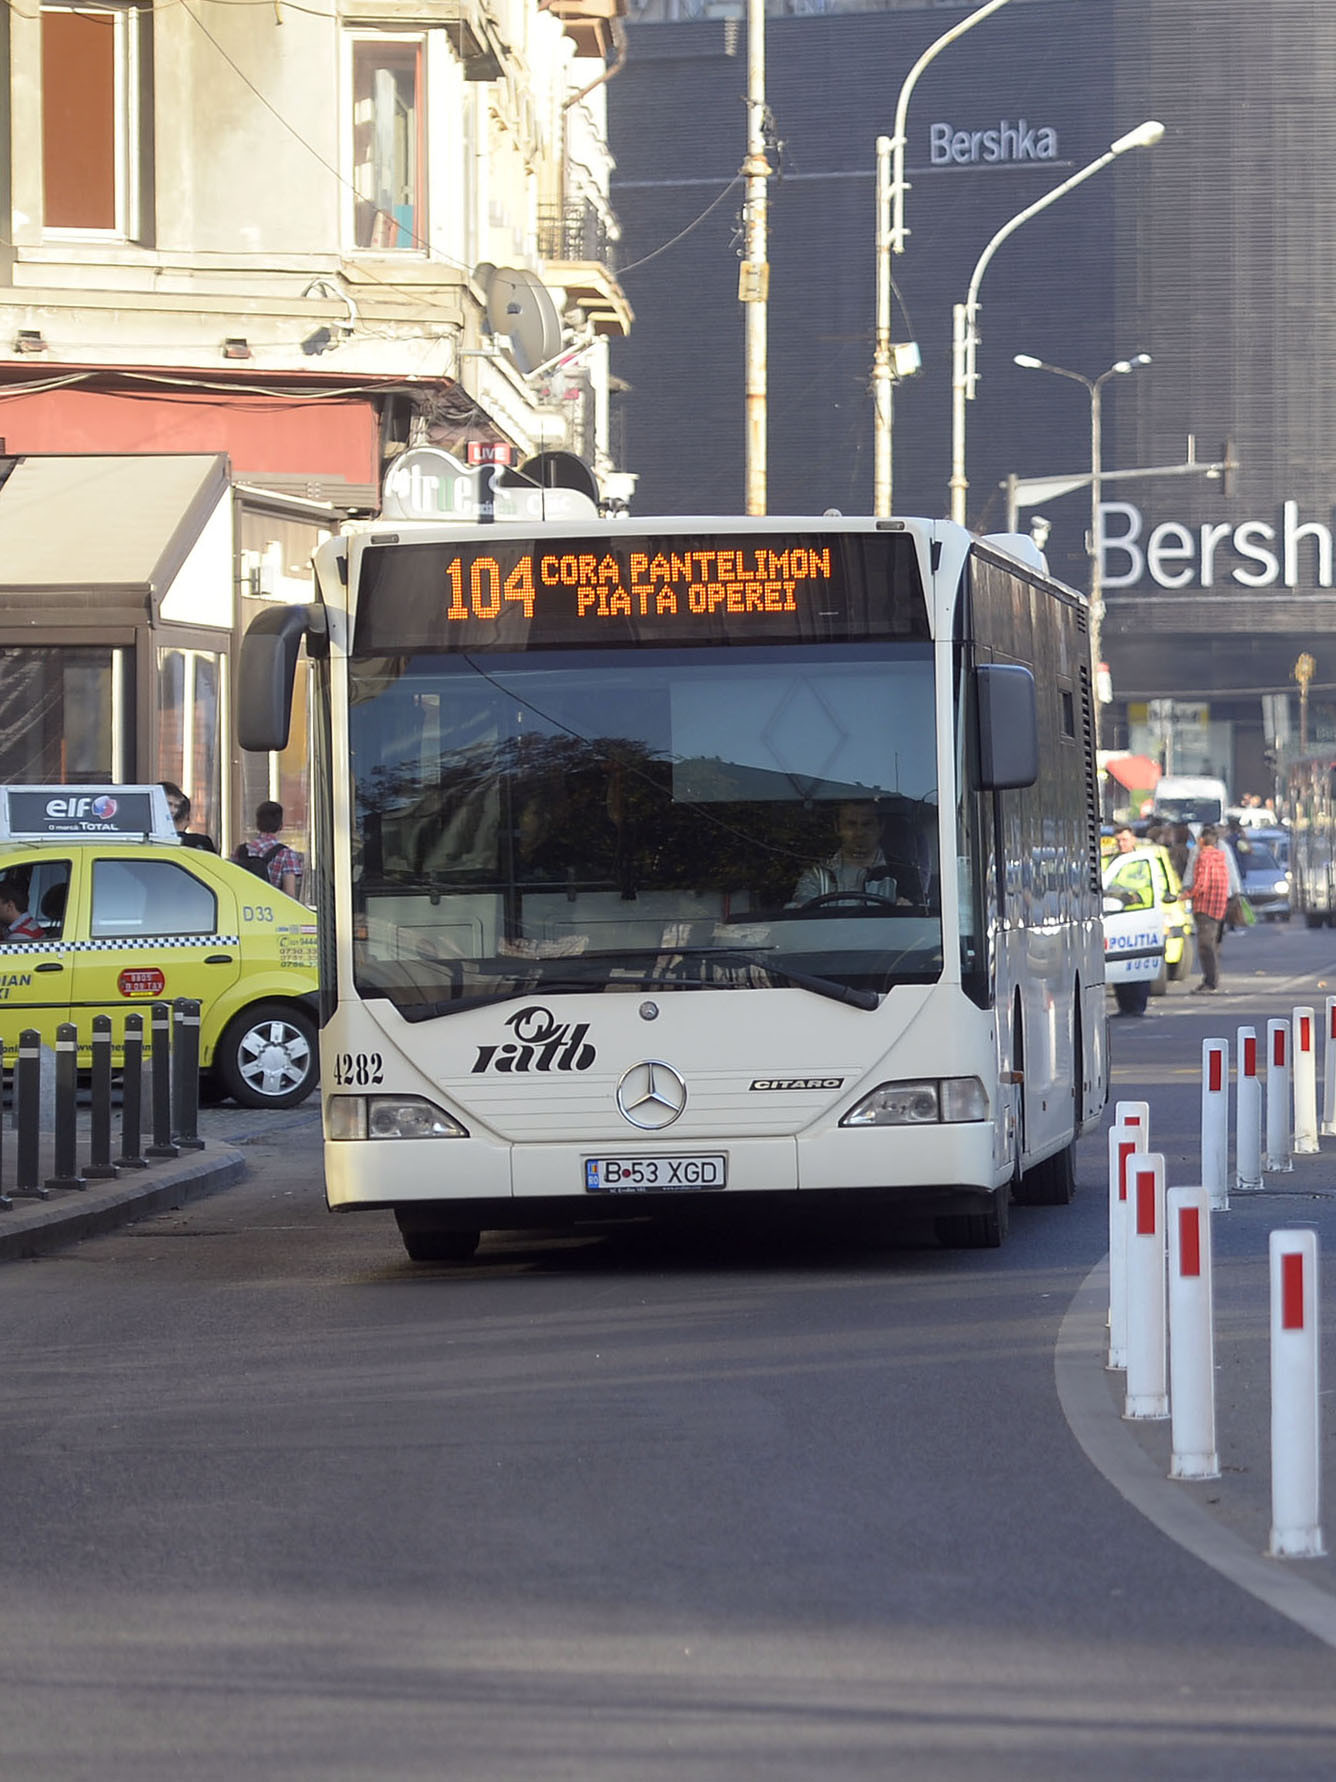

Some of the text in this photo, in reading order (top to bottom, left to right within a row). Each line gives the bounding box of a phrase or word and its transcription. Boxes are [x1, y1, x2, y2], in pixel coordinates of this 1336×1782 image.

[929, 118, 1058, 165] Bershka
[473, 446, 506, 461] LIVE
[541, 547, 832, 585] CORA PANTELIMON
[446, 555, 537, 620] 104
[577, 580, 797, 617] PIATA OPEREI
[46, 797, 92, 818] elf
[79, 821, 119, 831] TOTAL
[0, 974, 32, 987] IAN
[333, 1052, 384, 1086] 4282
[753, 1079, 841, 1089] CITARO
[604, 1161, 717, 1183] B 53 XGD
